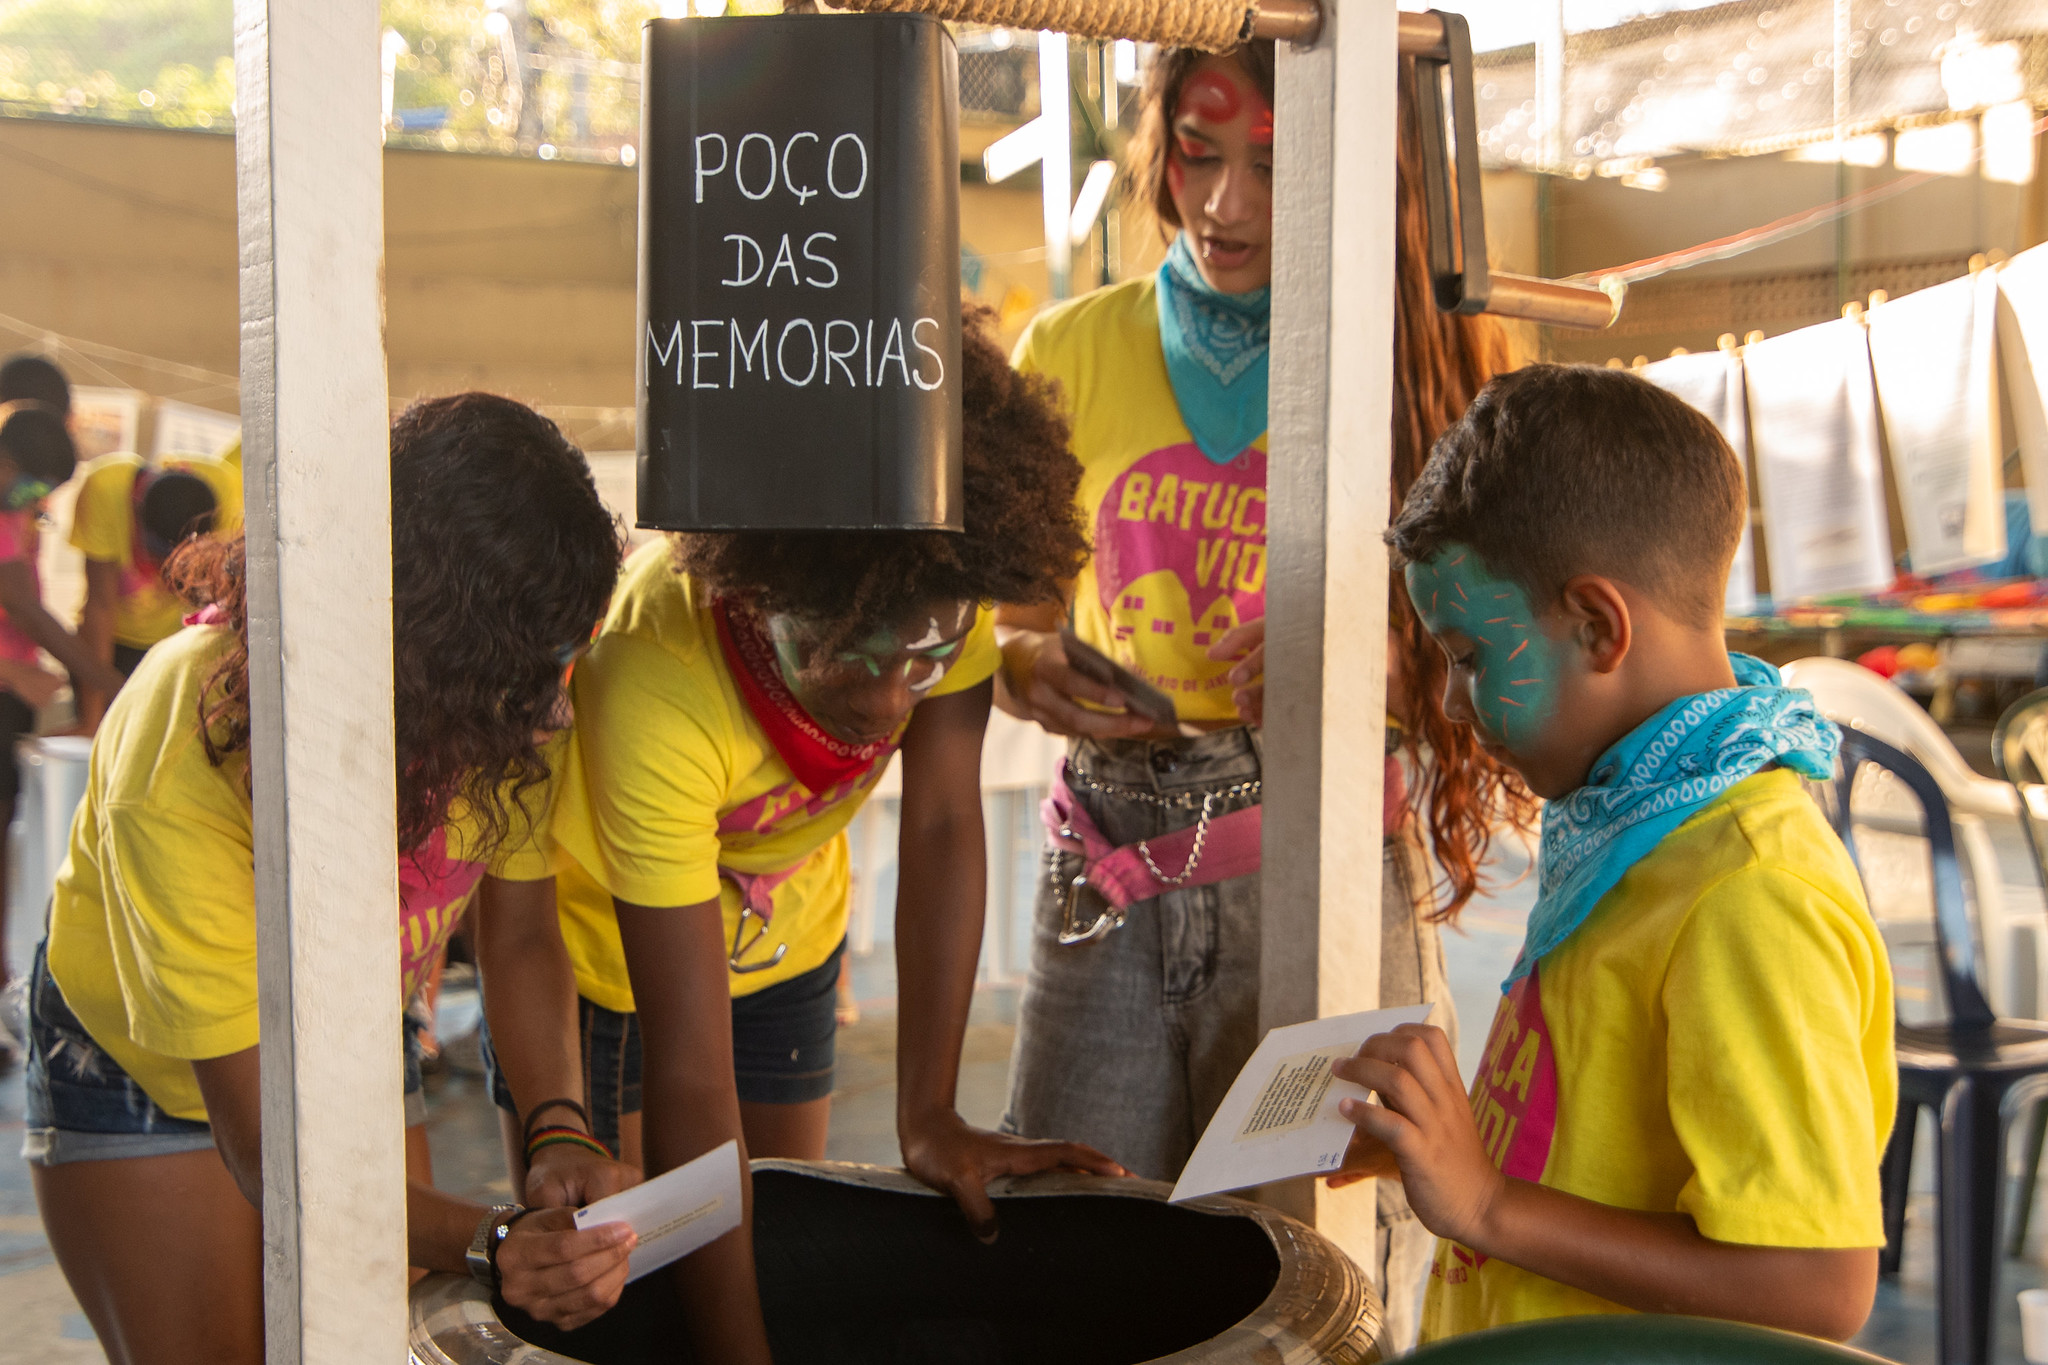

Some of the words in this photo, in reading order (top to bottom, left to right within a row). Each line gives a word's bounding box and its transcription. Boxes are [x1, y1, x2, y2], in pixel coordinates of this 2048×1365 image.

[695, 132, 868, 206] POÇO
[721, 232, 839, 288] DAS
[645, 317, 945, 391] MEMORIAS
[1117, 471, 1267, 537] BATUC
